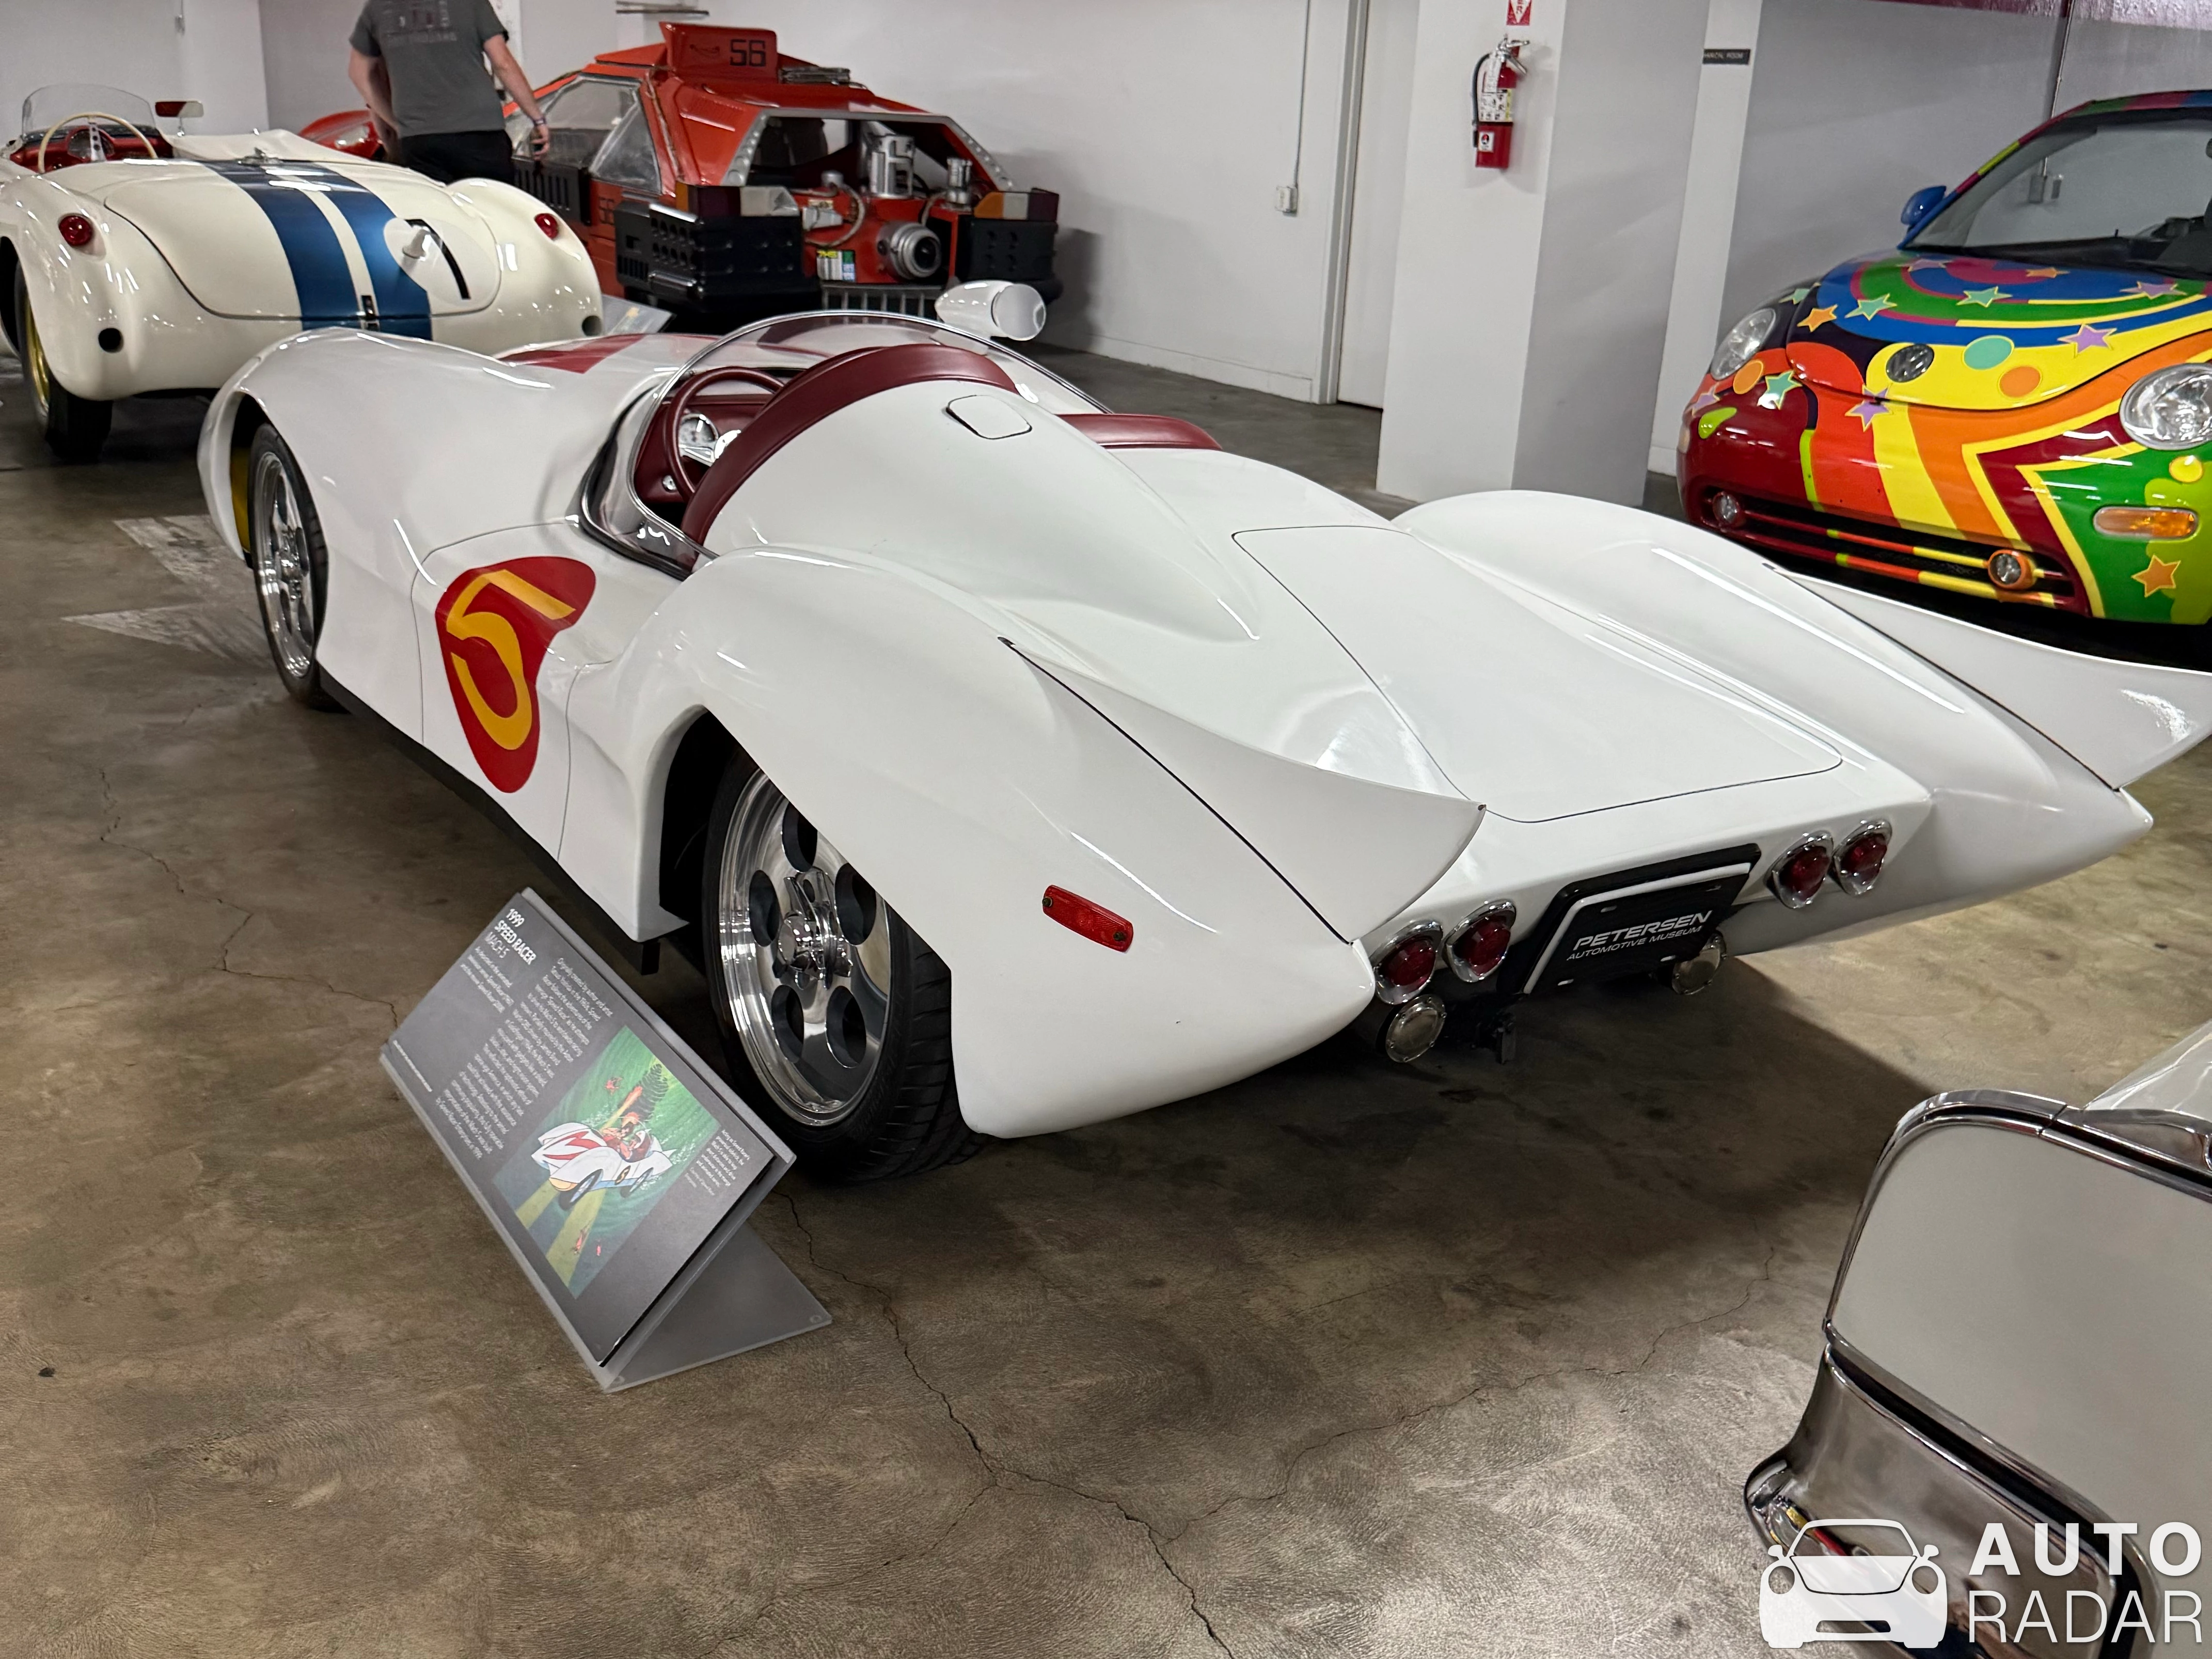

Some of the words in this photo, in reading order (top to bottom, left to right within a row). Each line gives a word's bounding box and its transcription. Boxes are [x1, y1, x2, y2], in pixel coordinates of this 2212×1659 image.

[730, 39, 766, 67] 56
[446, 569, 576, 750] 5
[507, 908, 524, 927] 1999
[1572, 910, 1713, 951] PETERSEN
[485, 931, 504, 954] MACH
[499, 948, 510, 958] 5
[495, 920, 517, 943] SPEED
[512, 938, 536, 964] RACER
[1567, 938, 1646, 961] AUTOMOTIVE
[1649, 925, 1703, 943] MUSEUM
